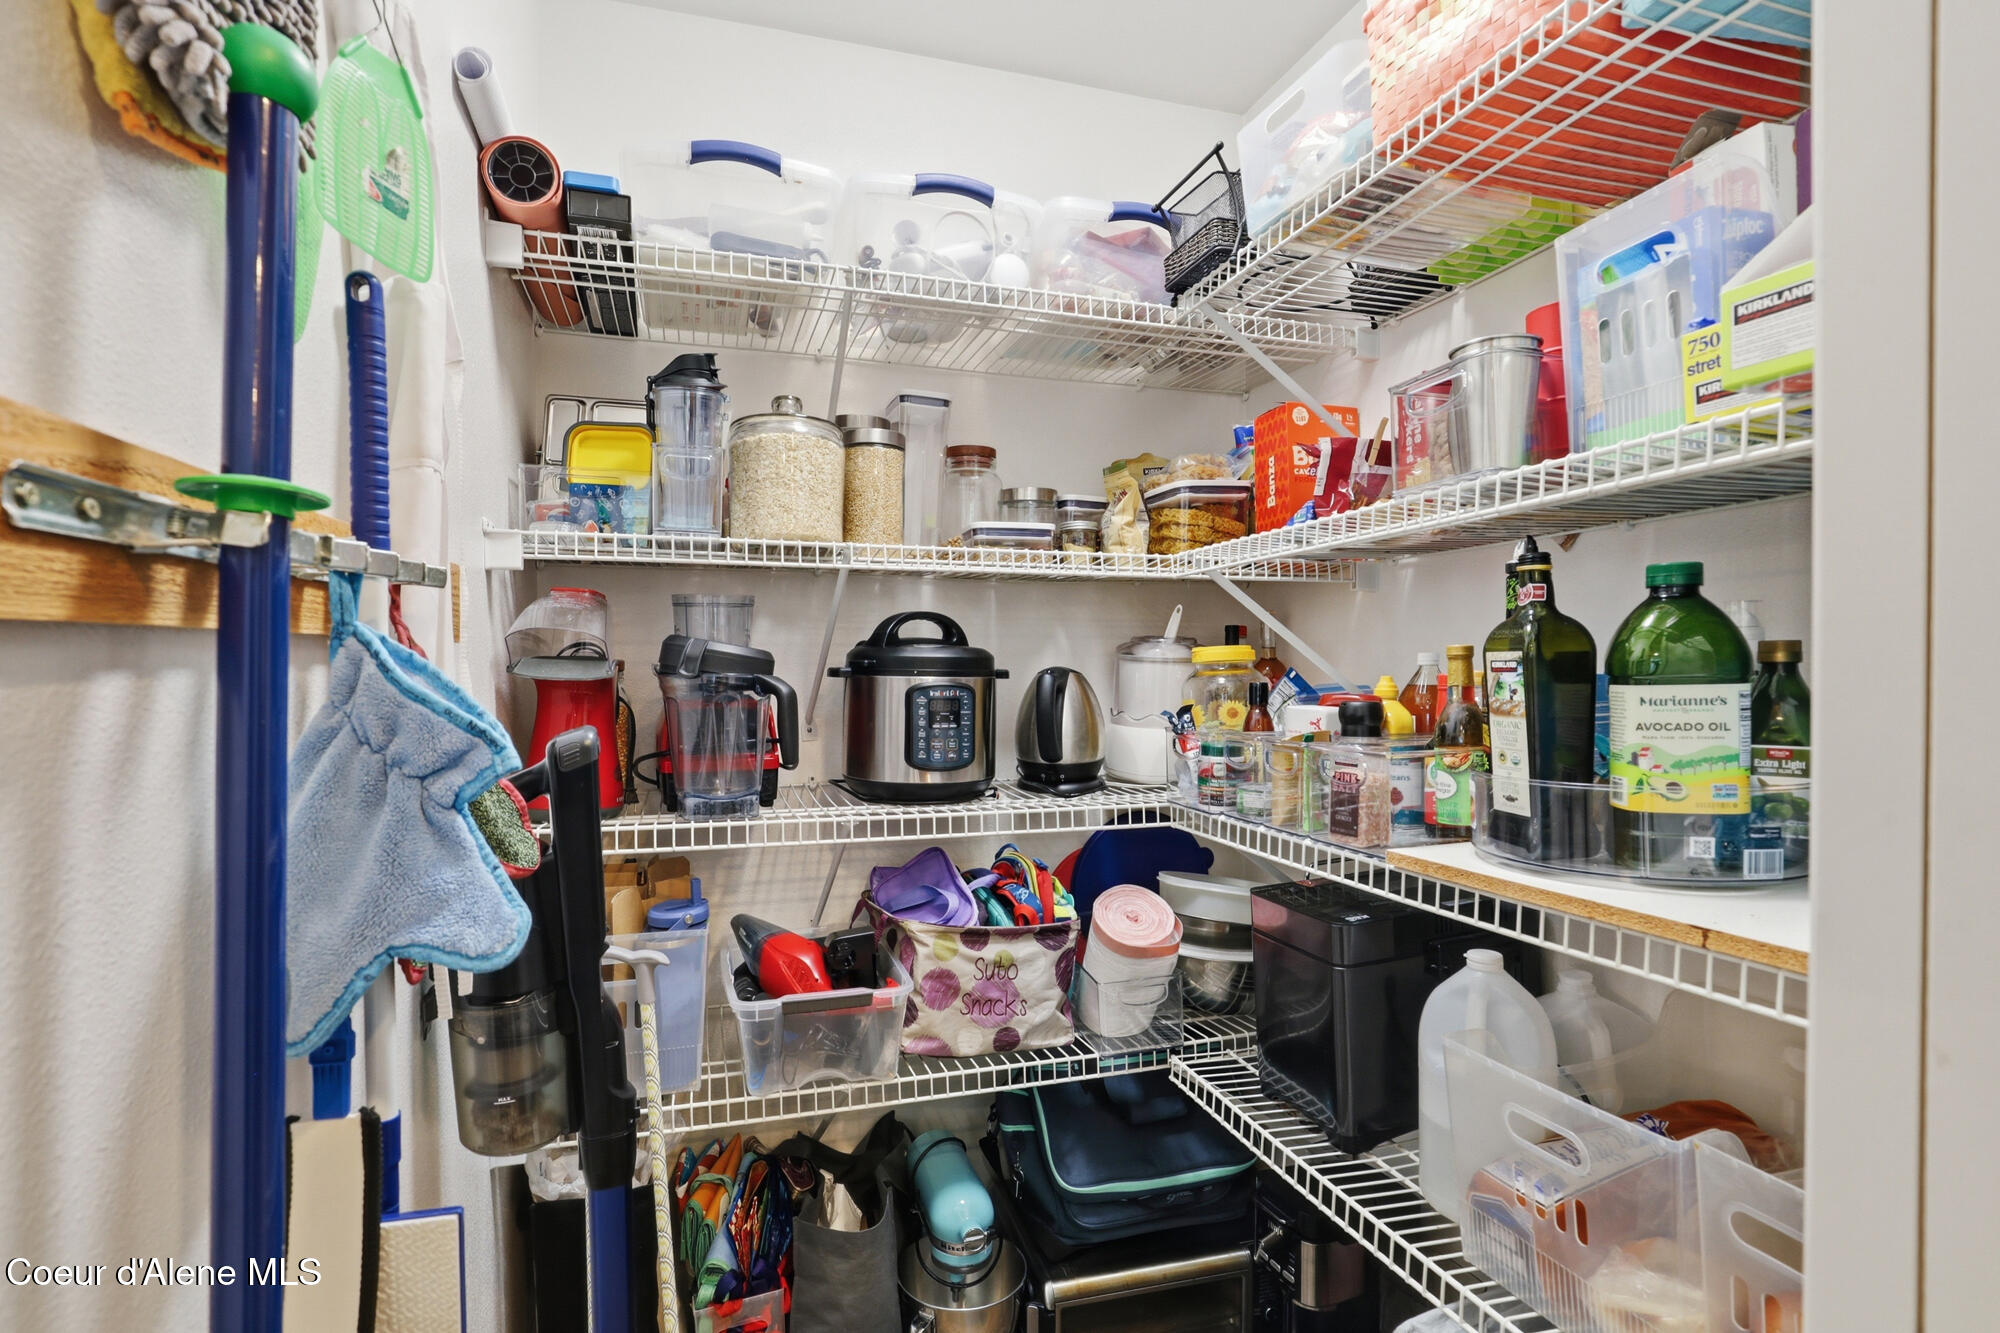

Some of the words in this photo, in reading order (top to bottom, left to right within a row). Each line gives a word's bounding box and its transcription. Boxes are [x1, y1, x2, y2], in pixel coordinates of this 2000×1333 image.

[1737, 282, 1814, 316] KIRKLAND
[1687, 331, 1720, 356] 750
[1266, 455, 1277, 509] Banza
[1639, 695, 1728, 707] Marianne's
[1635, 722, 1705, 732] AVOCADO
[1707, 722, 1731, 732] OIL
[1781, 759, 1806, 770] Light
[1334, 771, 1358, 784] PINK
[960, 990, 1028, 1017] Snacks
